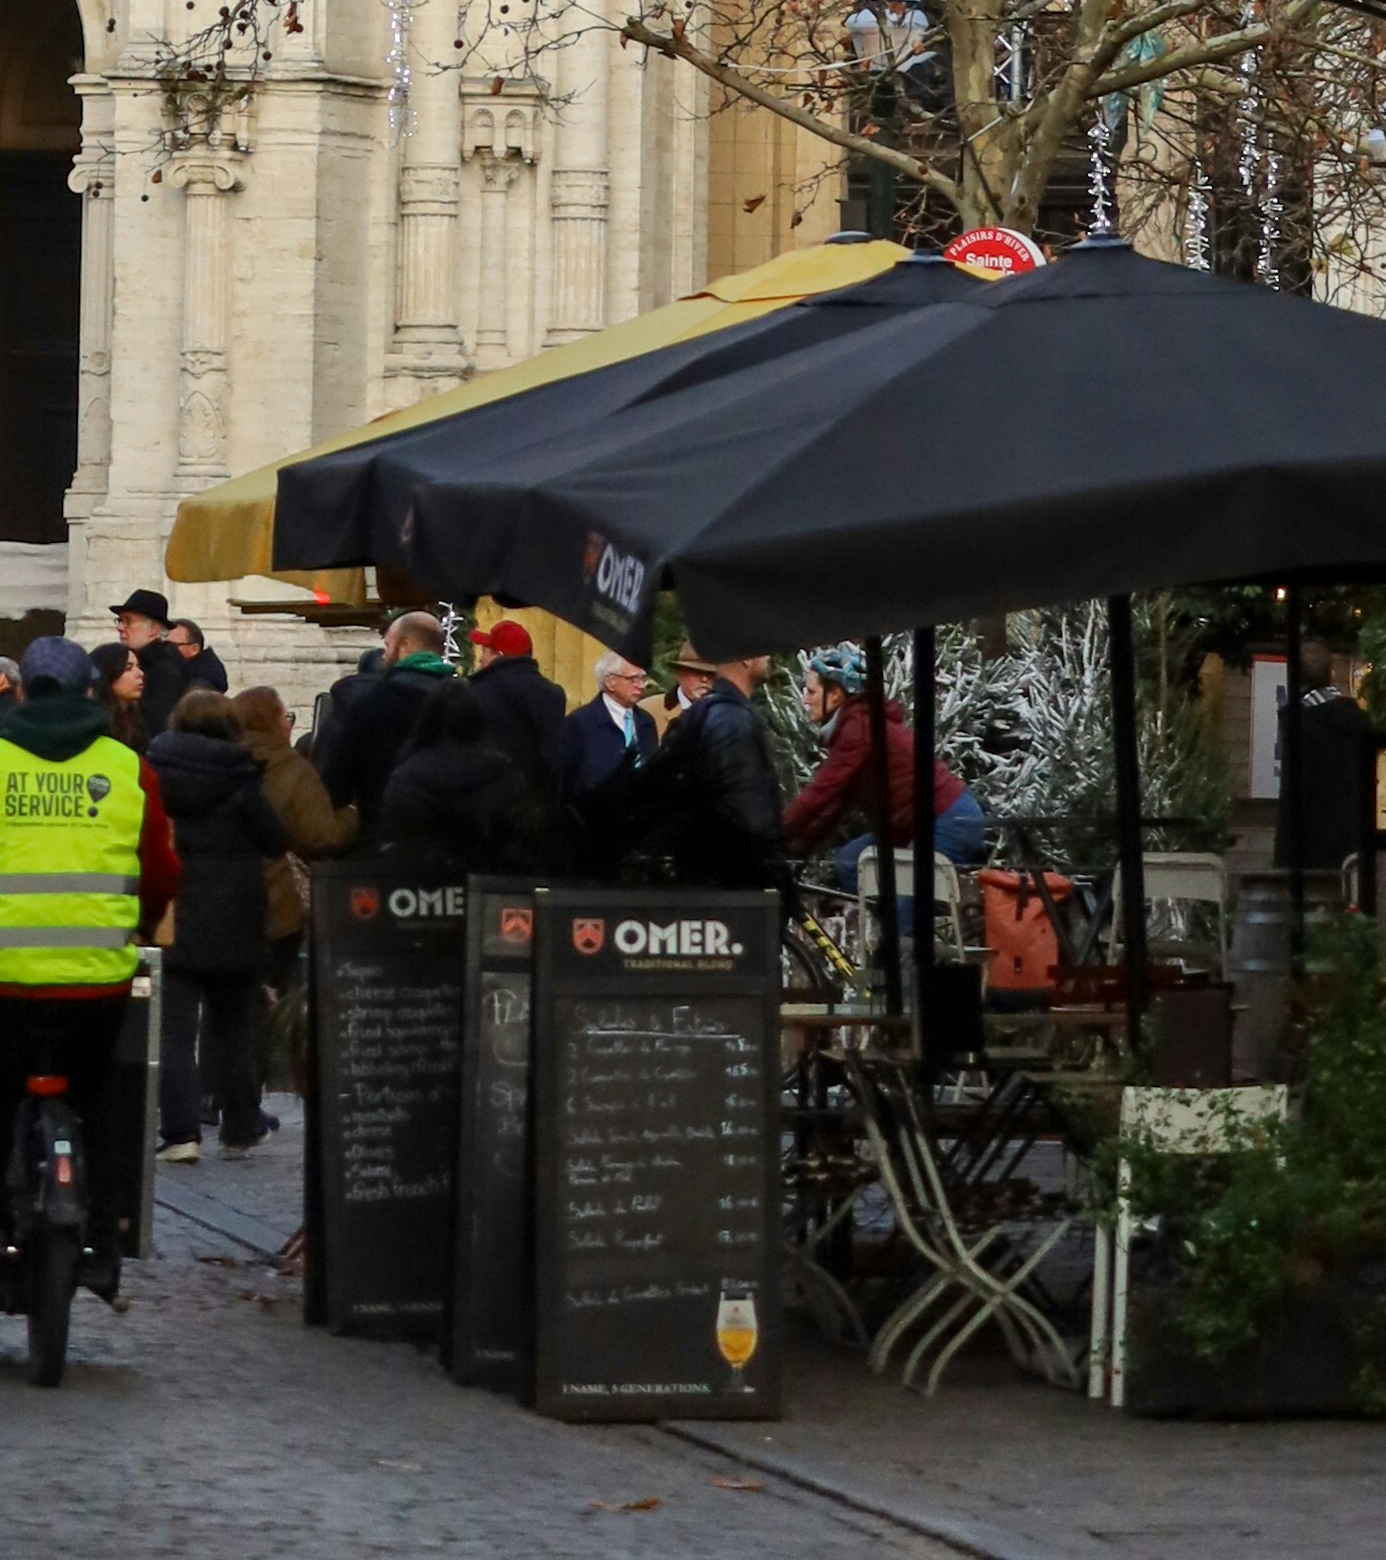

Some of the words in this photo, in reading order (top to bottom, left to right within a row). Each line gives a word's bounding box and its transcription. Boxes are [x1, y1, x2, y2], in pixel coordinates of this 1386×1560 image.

[949, 230, 994, 257] PLAISIRS
[995, 231, 1031, 262] D'HIVER
[965, 252, 1013, 268] Sainte
[6, 771, 29, 793] AT
[35, 772, 84, 795] YOUR
[5, 794, 84, 818] SERVICE
[388, 886, 465, 918] OME
[613, 919, 744, 955] OMER.
